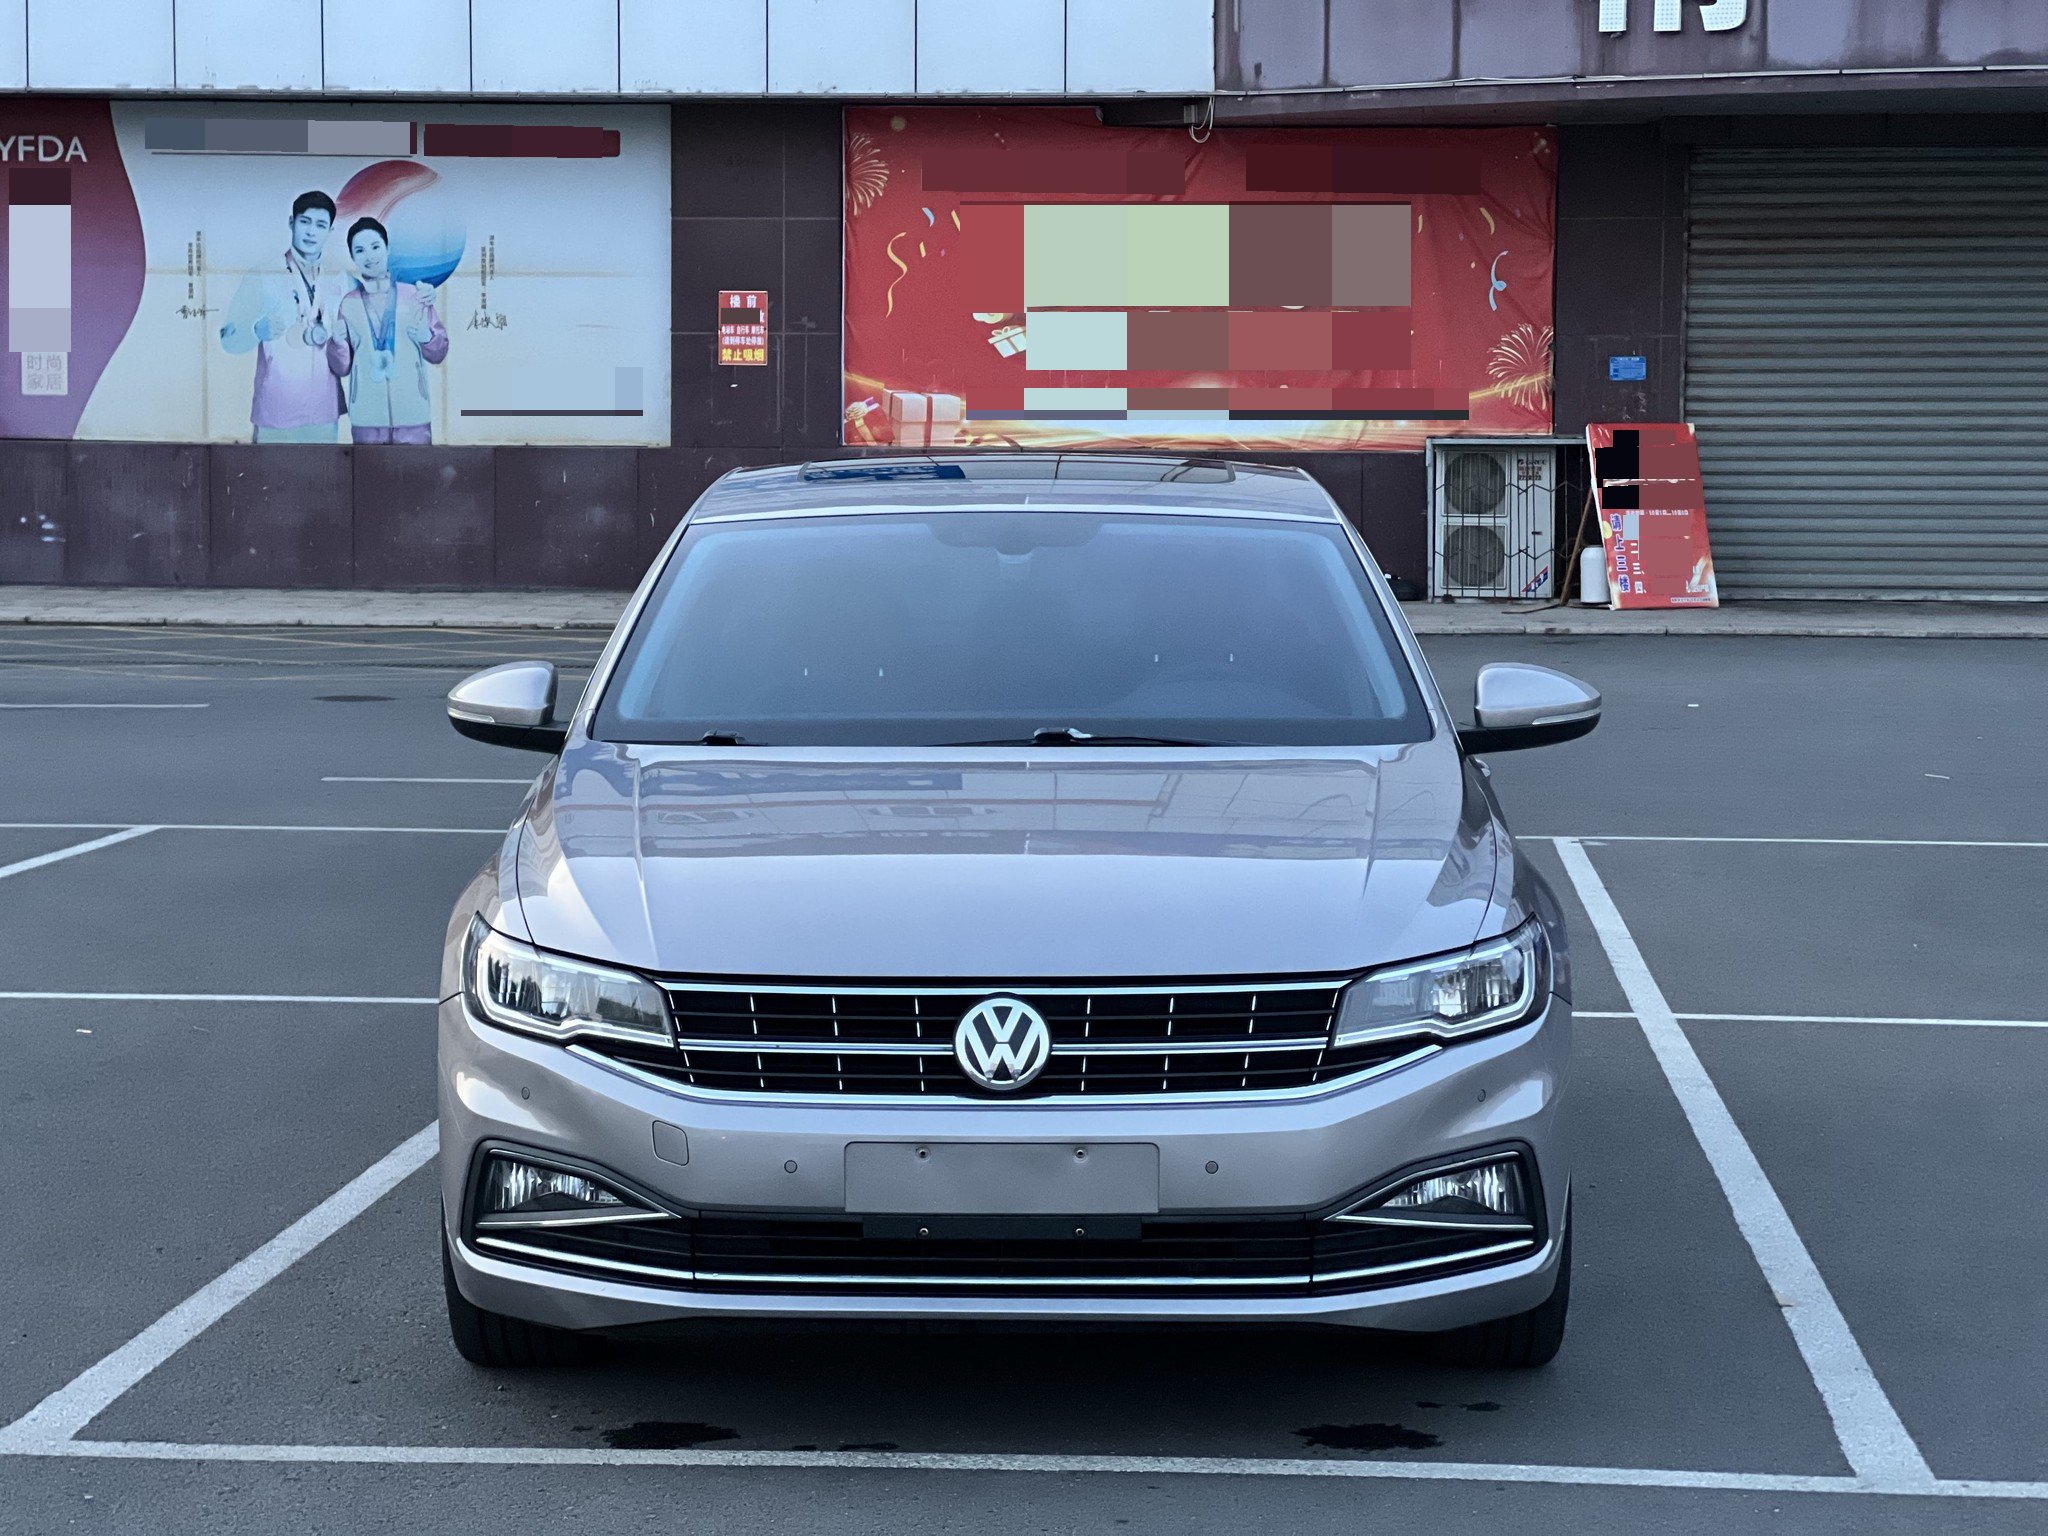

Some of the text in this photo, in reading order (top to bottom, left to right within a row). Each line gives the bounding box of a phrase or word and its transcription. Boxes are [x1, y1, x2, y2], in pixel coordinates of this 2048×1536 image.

[0, 135, 87, 162] YFDA
[722, 348, 764, 361] 禁止吸烟
[1610, 513, 1630, 593] 请上三楼
